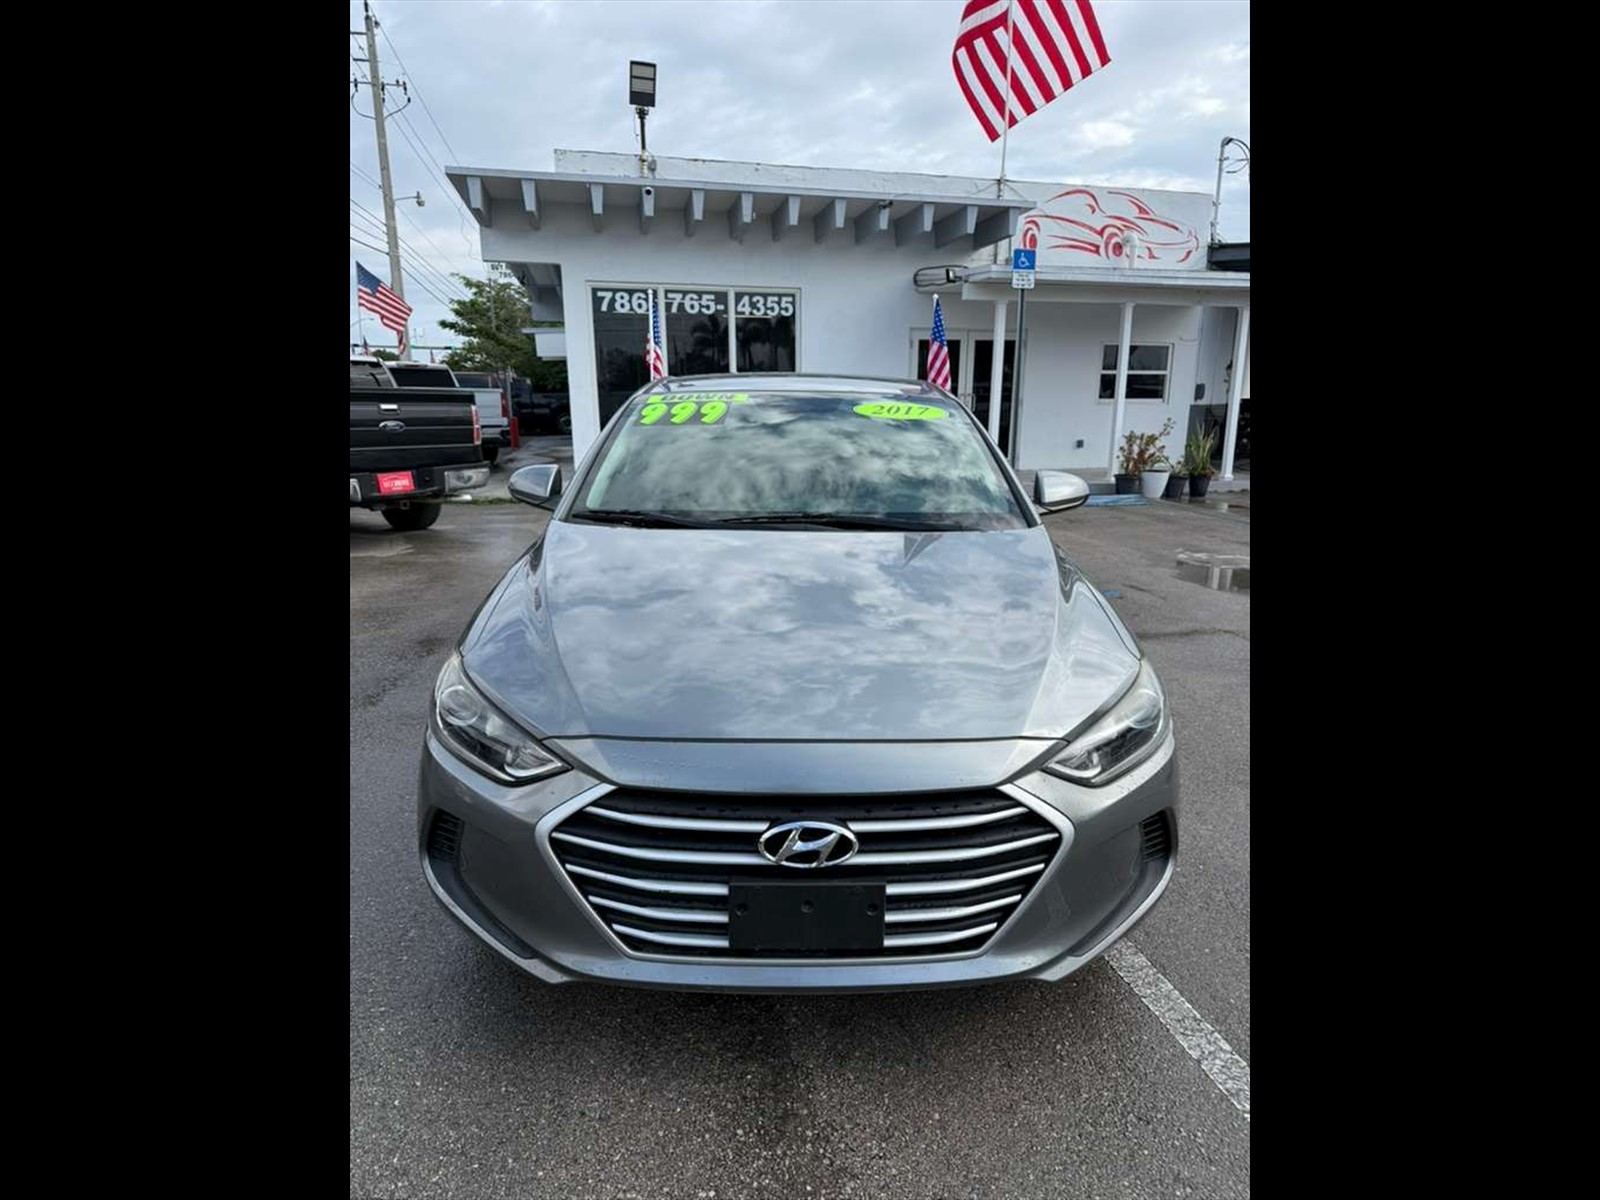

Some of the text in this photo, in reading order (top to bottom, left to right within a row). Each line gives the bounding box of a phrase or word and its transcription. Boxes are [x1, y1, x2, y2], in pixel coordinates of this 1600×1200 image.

[597, 291, 648, 314] 786
[737, 295, 794, 317] 4355
[640, 401, 727, 424] 999
[871, 404, 930, 416] 2017
